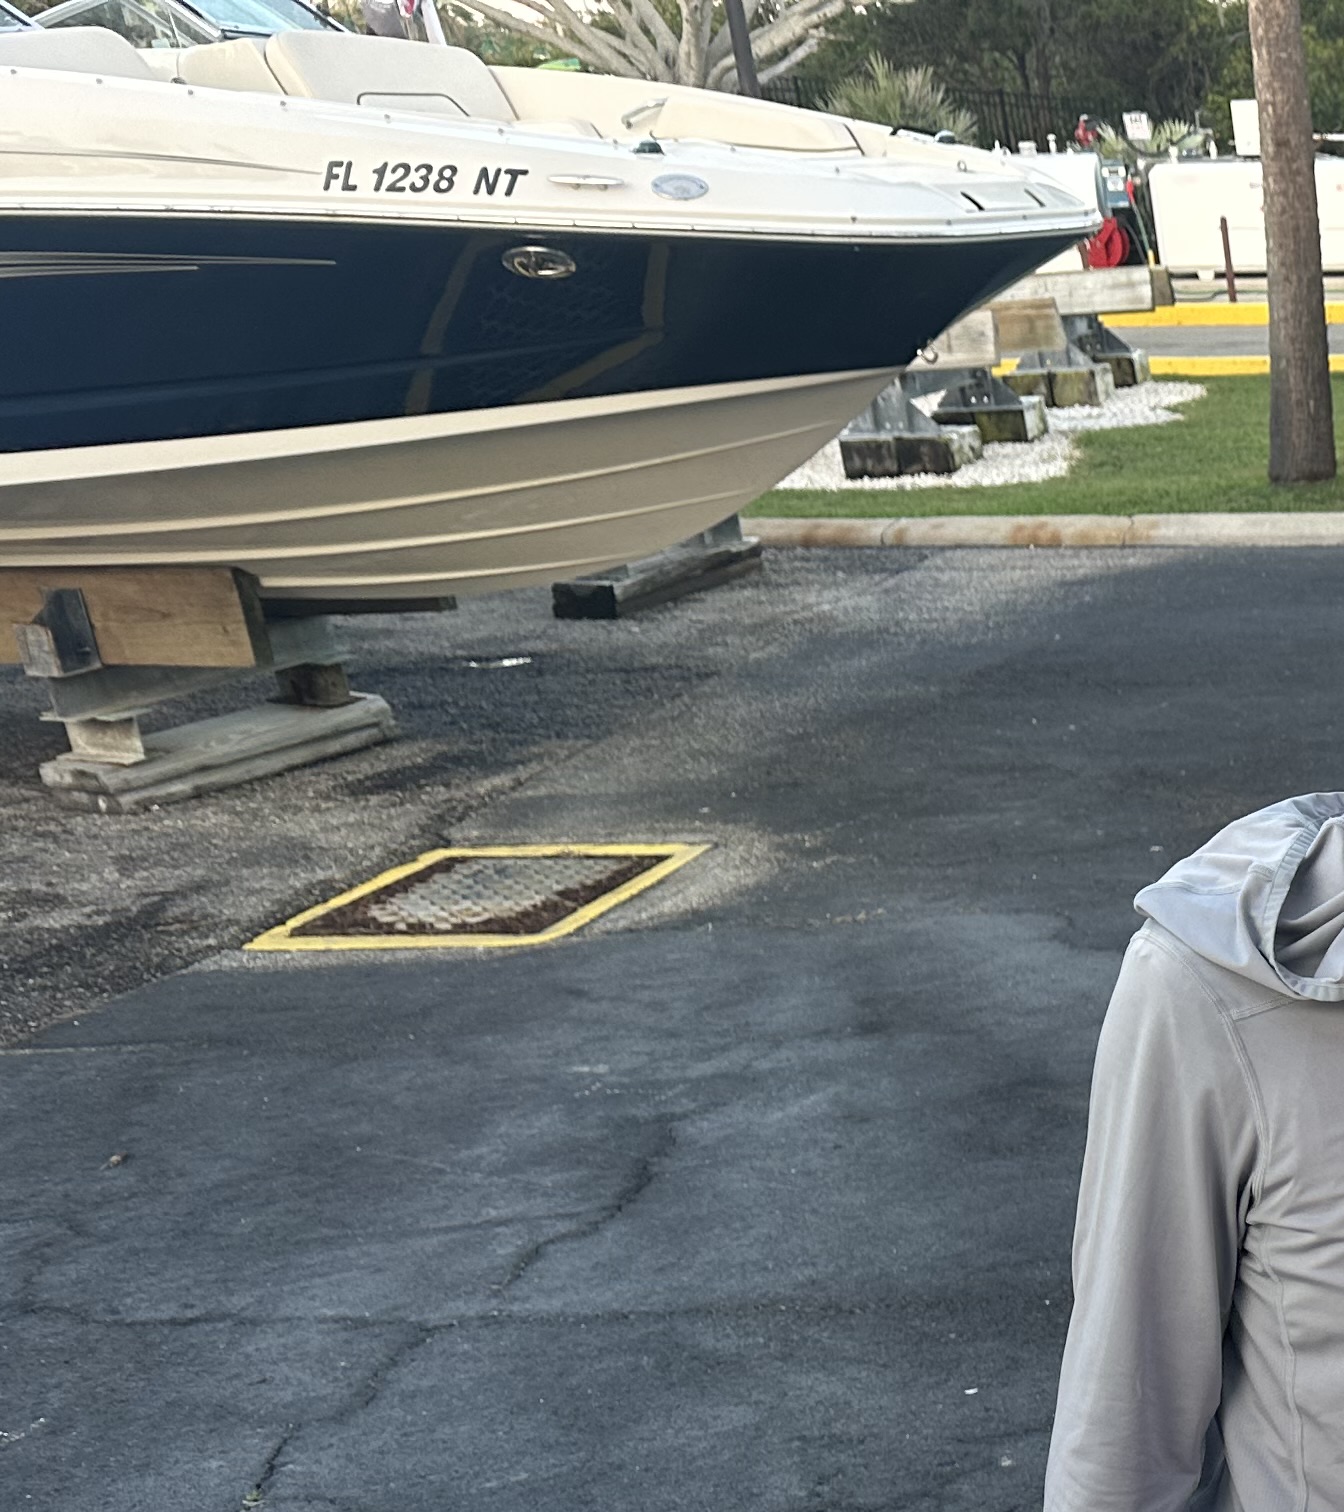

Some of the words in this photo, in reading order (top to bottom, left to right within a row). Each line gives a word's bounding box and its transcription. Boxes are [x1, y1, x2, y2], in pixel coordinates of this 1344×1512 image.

[323, 160, 358, 191] FL
[372, 161, 458, 193] 1238
[472, 166, 529, 197] NT
